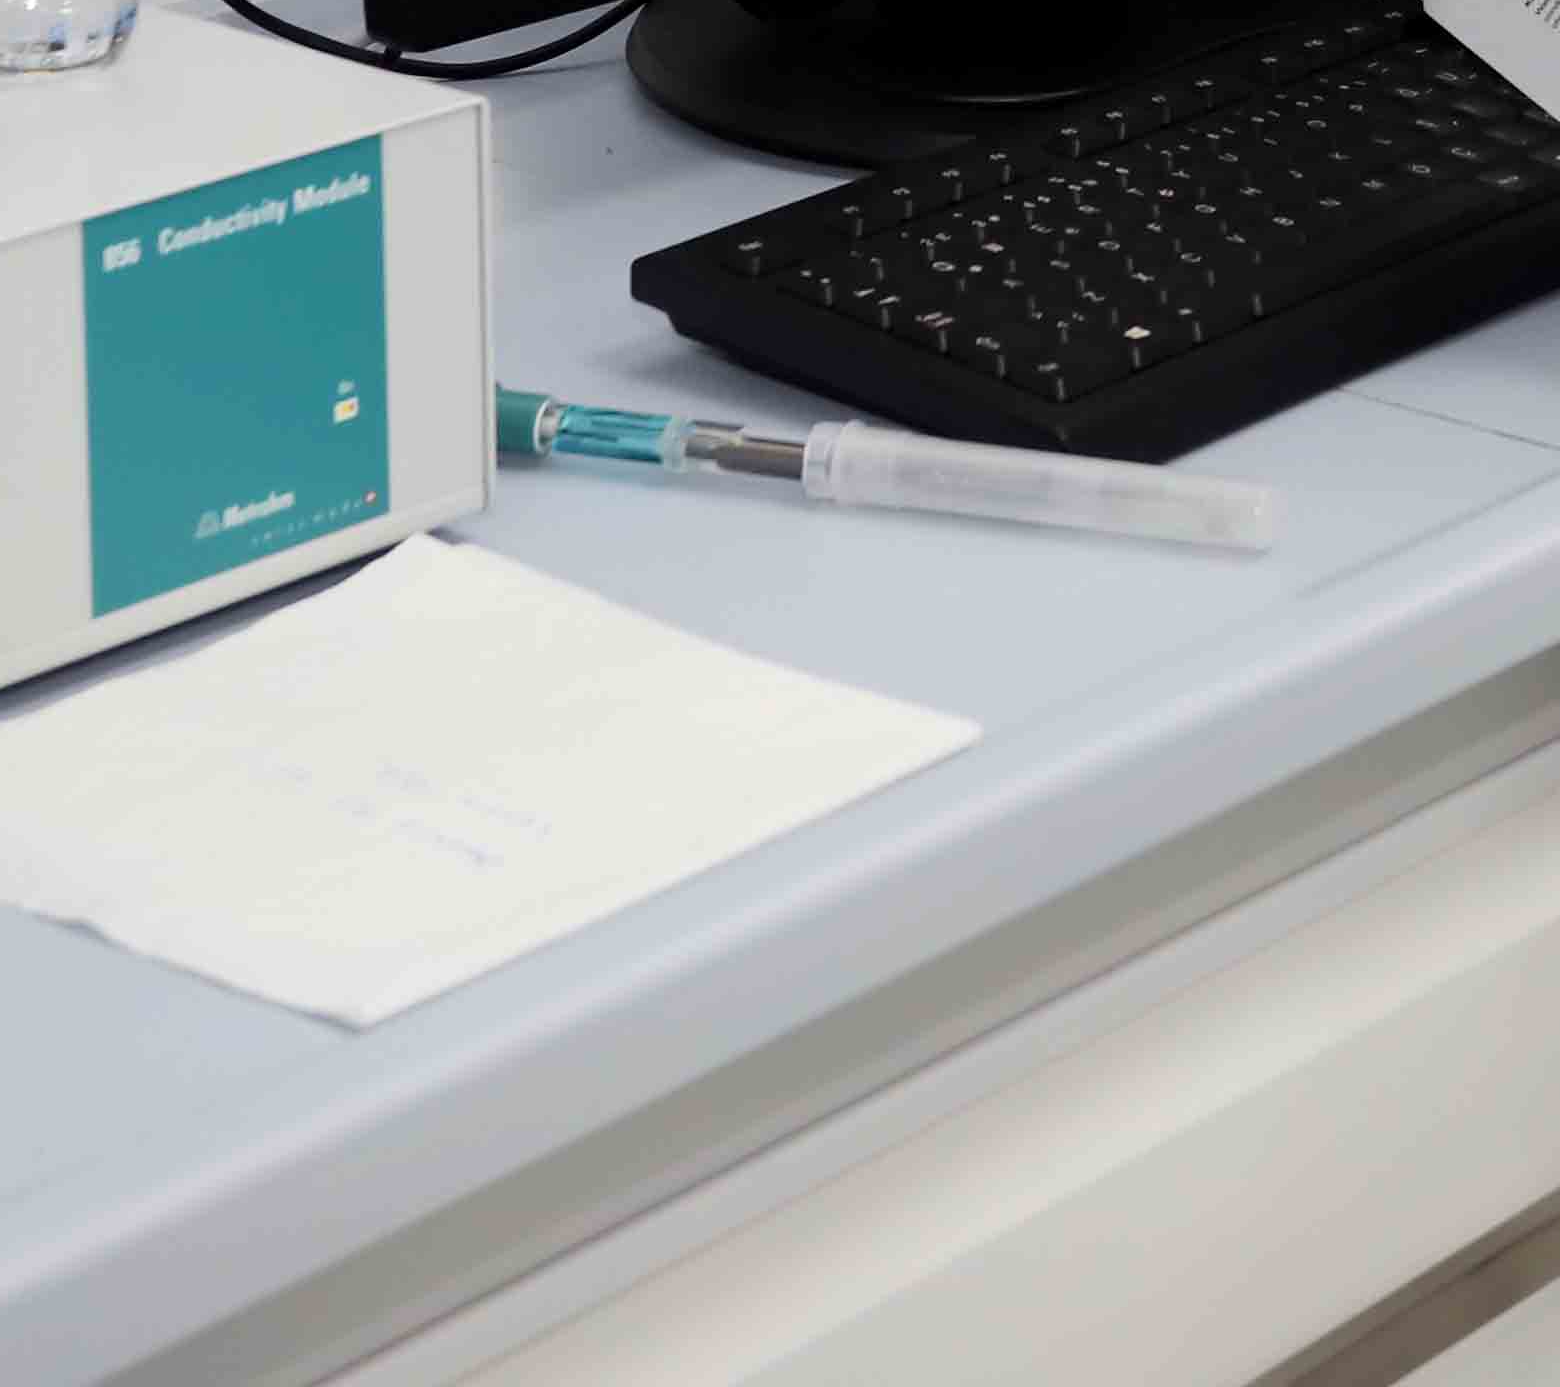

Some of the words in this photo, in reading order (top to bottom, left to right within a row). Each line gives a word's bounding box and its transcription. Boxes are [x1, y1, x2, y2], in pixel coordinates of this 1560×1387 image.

[158, 197, 287, 255] Conductivity
[292, 171, 372, 214] Module
[222, 491, 296, 530] Metrohm
